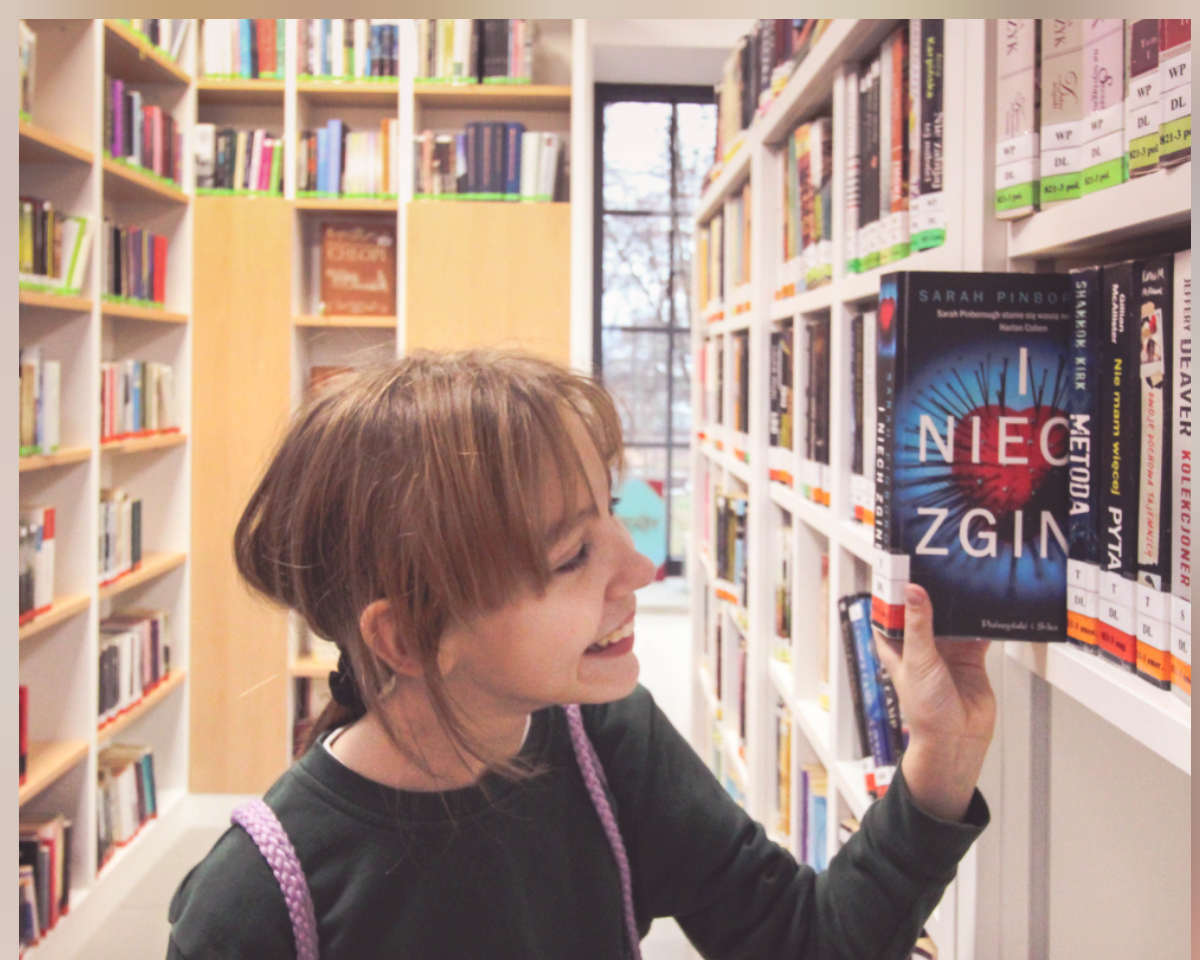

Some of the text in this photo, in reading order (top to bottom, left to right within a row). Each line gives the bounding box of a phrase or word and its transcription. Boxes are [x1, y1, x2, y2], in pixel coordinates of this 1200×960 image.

[1168, 63, 1187, 79] WP
[1137, 85, 1152, 98] WP
[1170, 96, 1187, 111] DL
[1137, 116, 1150, 129] DL
[1055, 130, 1073, 141] WP
[1160, 129, 1181, 145] 821-3
[1055, 158, 1069, 167] DL
[918, 289, 984, 303] SARAH
[1111, 283, 1120, 345] McAllister
[1118, 293, 1126, 333] Gillian
[1075, 280, 1087, 391] SHANNON KIRK
[1018, 346, 1028, 395] I
[1110, 358, 1123, 496] Nie mam więcej
[917, 414, 1069, 467] NIEC
[876, 421, 885, 483] NIECH
[1146, 433, 1155, 486] DOCHOWA
[1069, 414, 1091, 516] METODA
[1144, 492, 1154, 558] TAJEMNICY
[1180, 450, 1191, 588] KOLEKCJONER
[1107, 506, 1123, 573] PYTA
[1075, 569, 1081, 580] T
[1112, 583, 1117, 594] T
[1074, 596, 1086, 607] DL
[1145, 596, 1150, 608] T
[1108, 607, 1119, 621] DL
[1180, 610, 1185, 621] S
[1142, 624, 1153, 638] DL
[1178, 639, 1188, 653] DL
